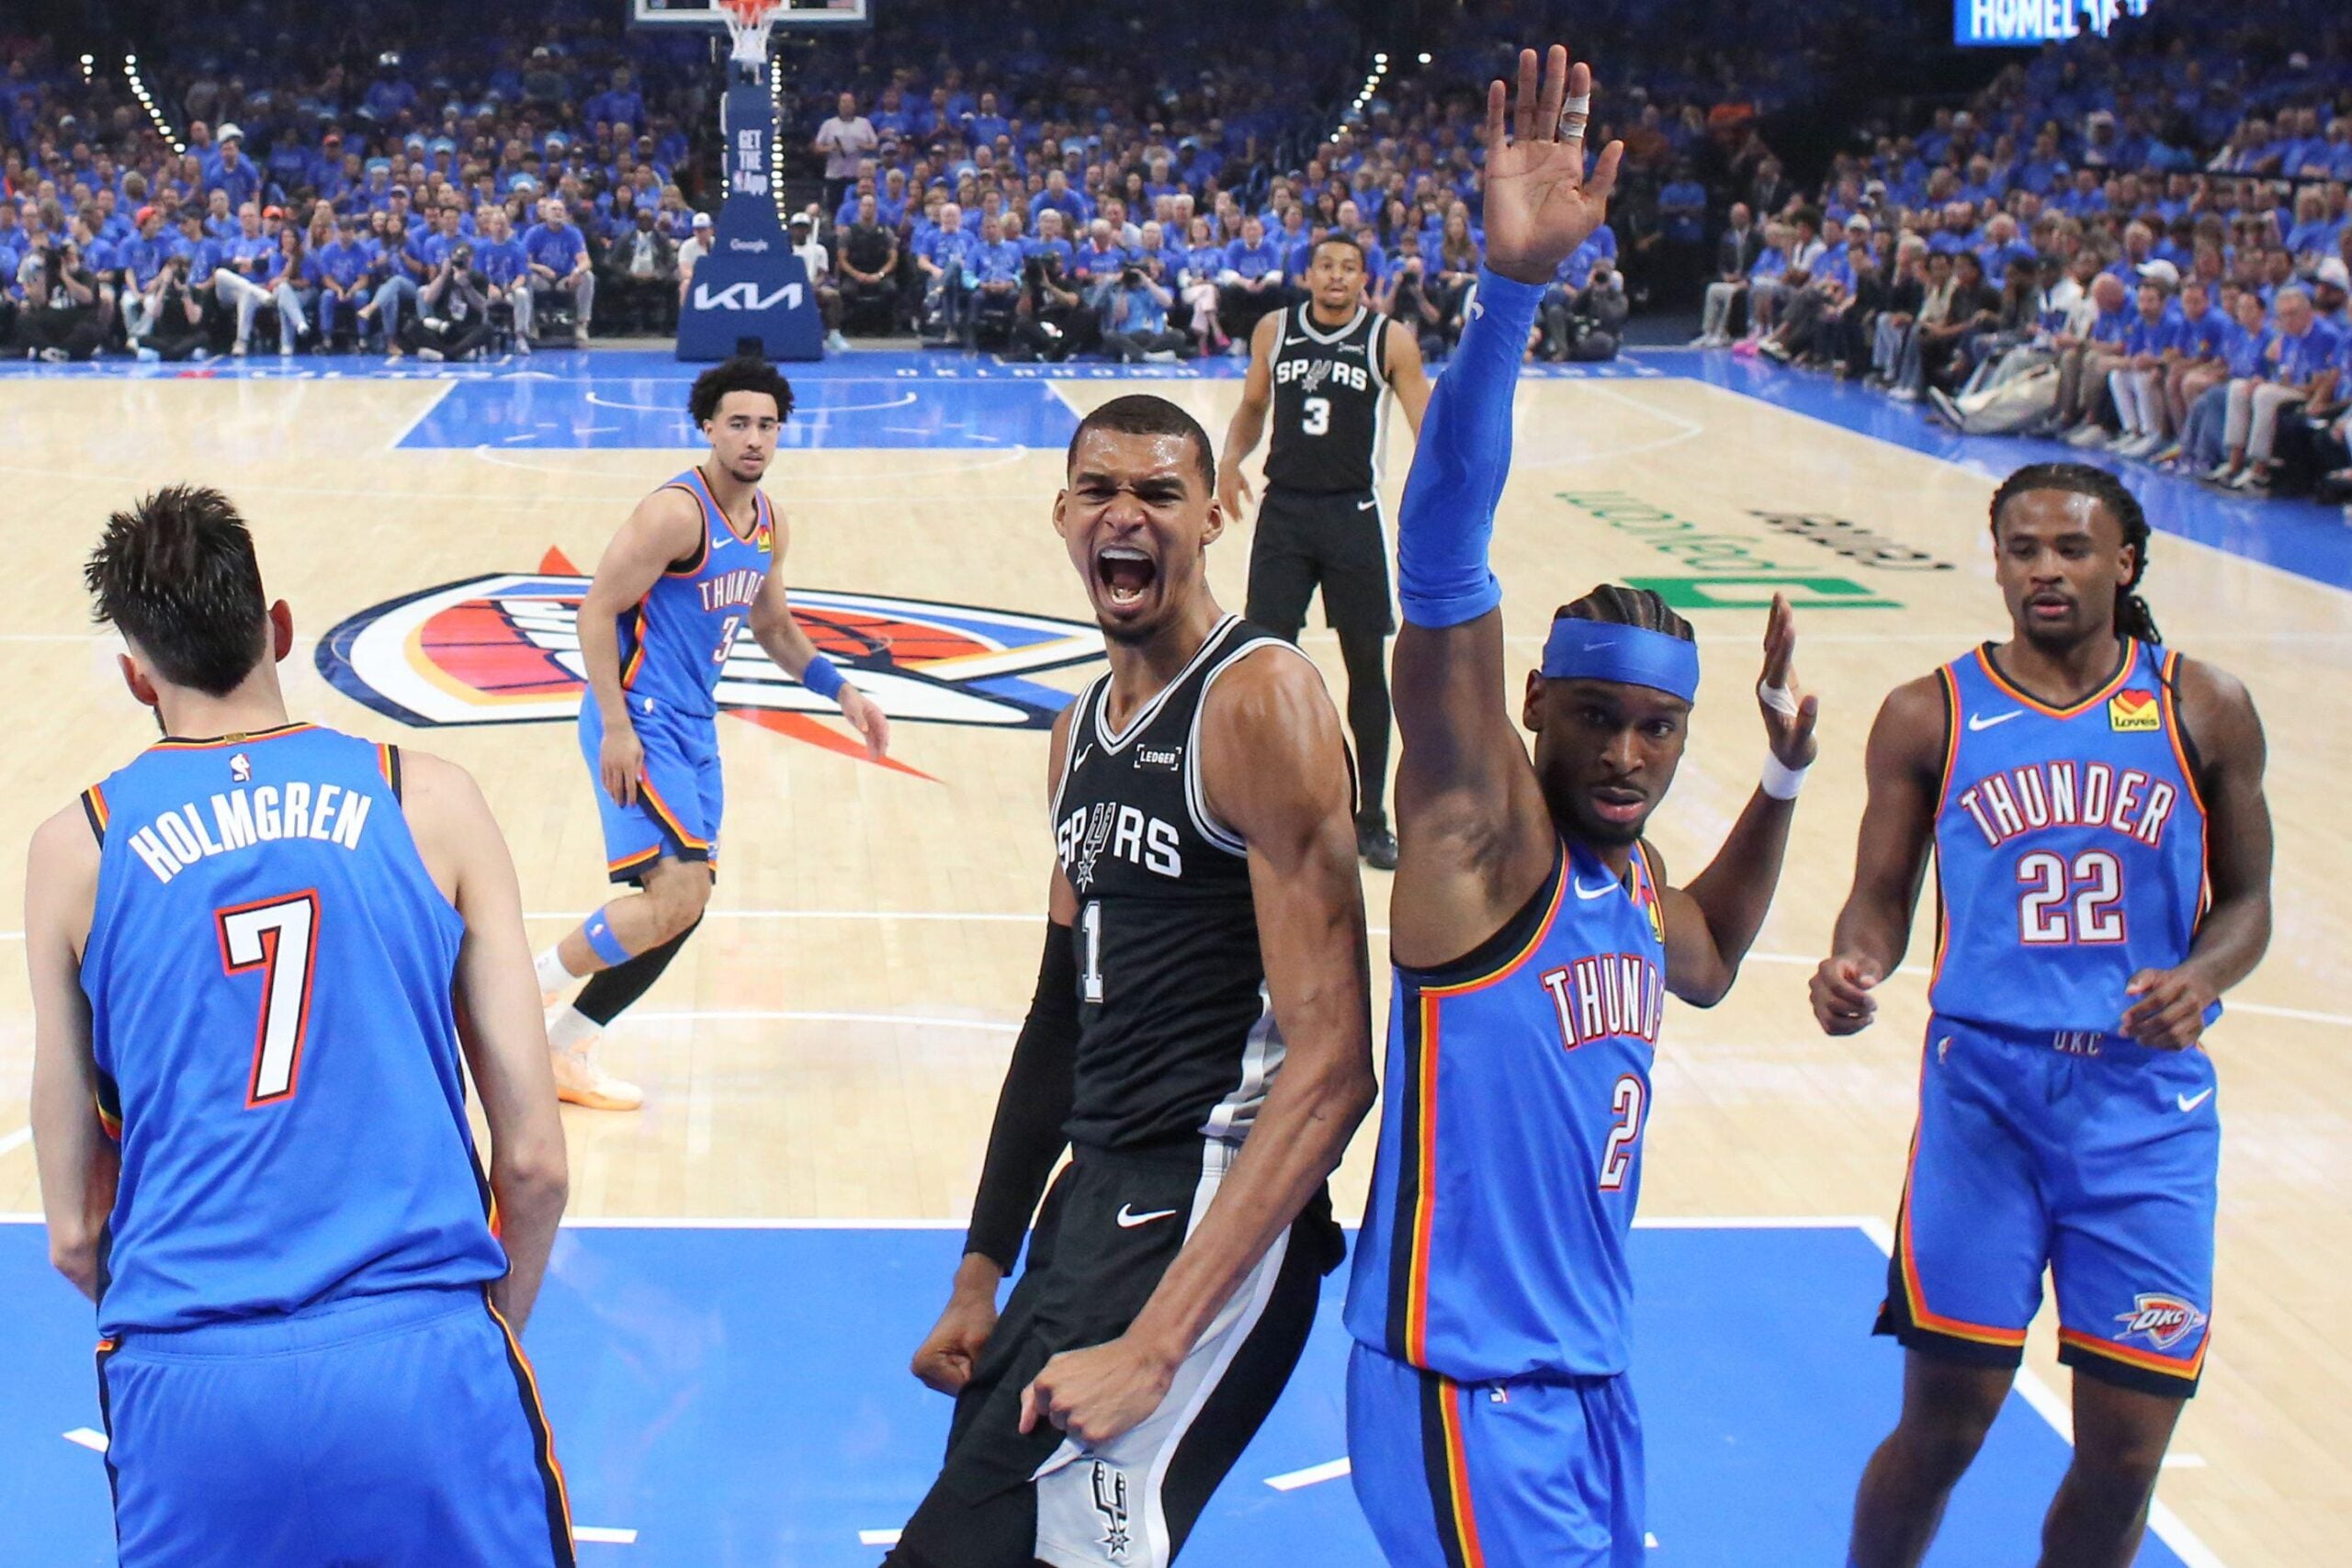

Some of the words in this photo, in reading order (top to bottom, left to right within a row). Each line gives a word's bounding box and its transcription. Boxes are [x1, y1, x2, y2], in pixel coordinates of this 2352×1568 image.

[739, 130, 762, 149] GET
[739, 150, 762, 170] THE
[730, 239, 768, 253] Google
[694, 283, 802, 310] KIA
[1303, 398, 1330, 436] 3
[713, 615, 739, 663] 3
[1140, 750, 1175, 763] LEDGER
[1961, 761, 2176, 849] THUNDER
[129, 782, 372, 885] HOLMGREN
[2017, 849, 2127, 945] 22
[1082, 900, 1103, 1003] 1
[214, 887, 322, 1110] 7
[1599, 1073, 1646, 1192] 2
